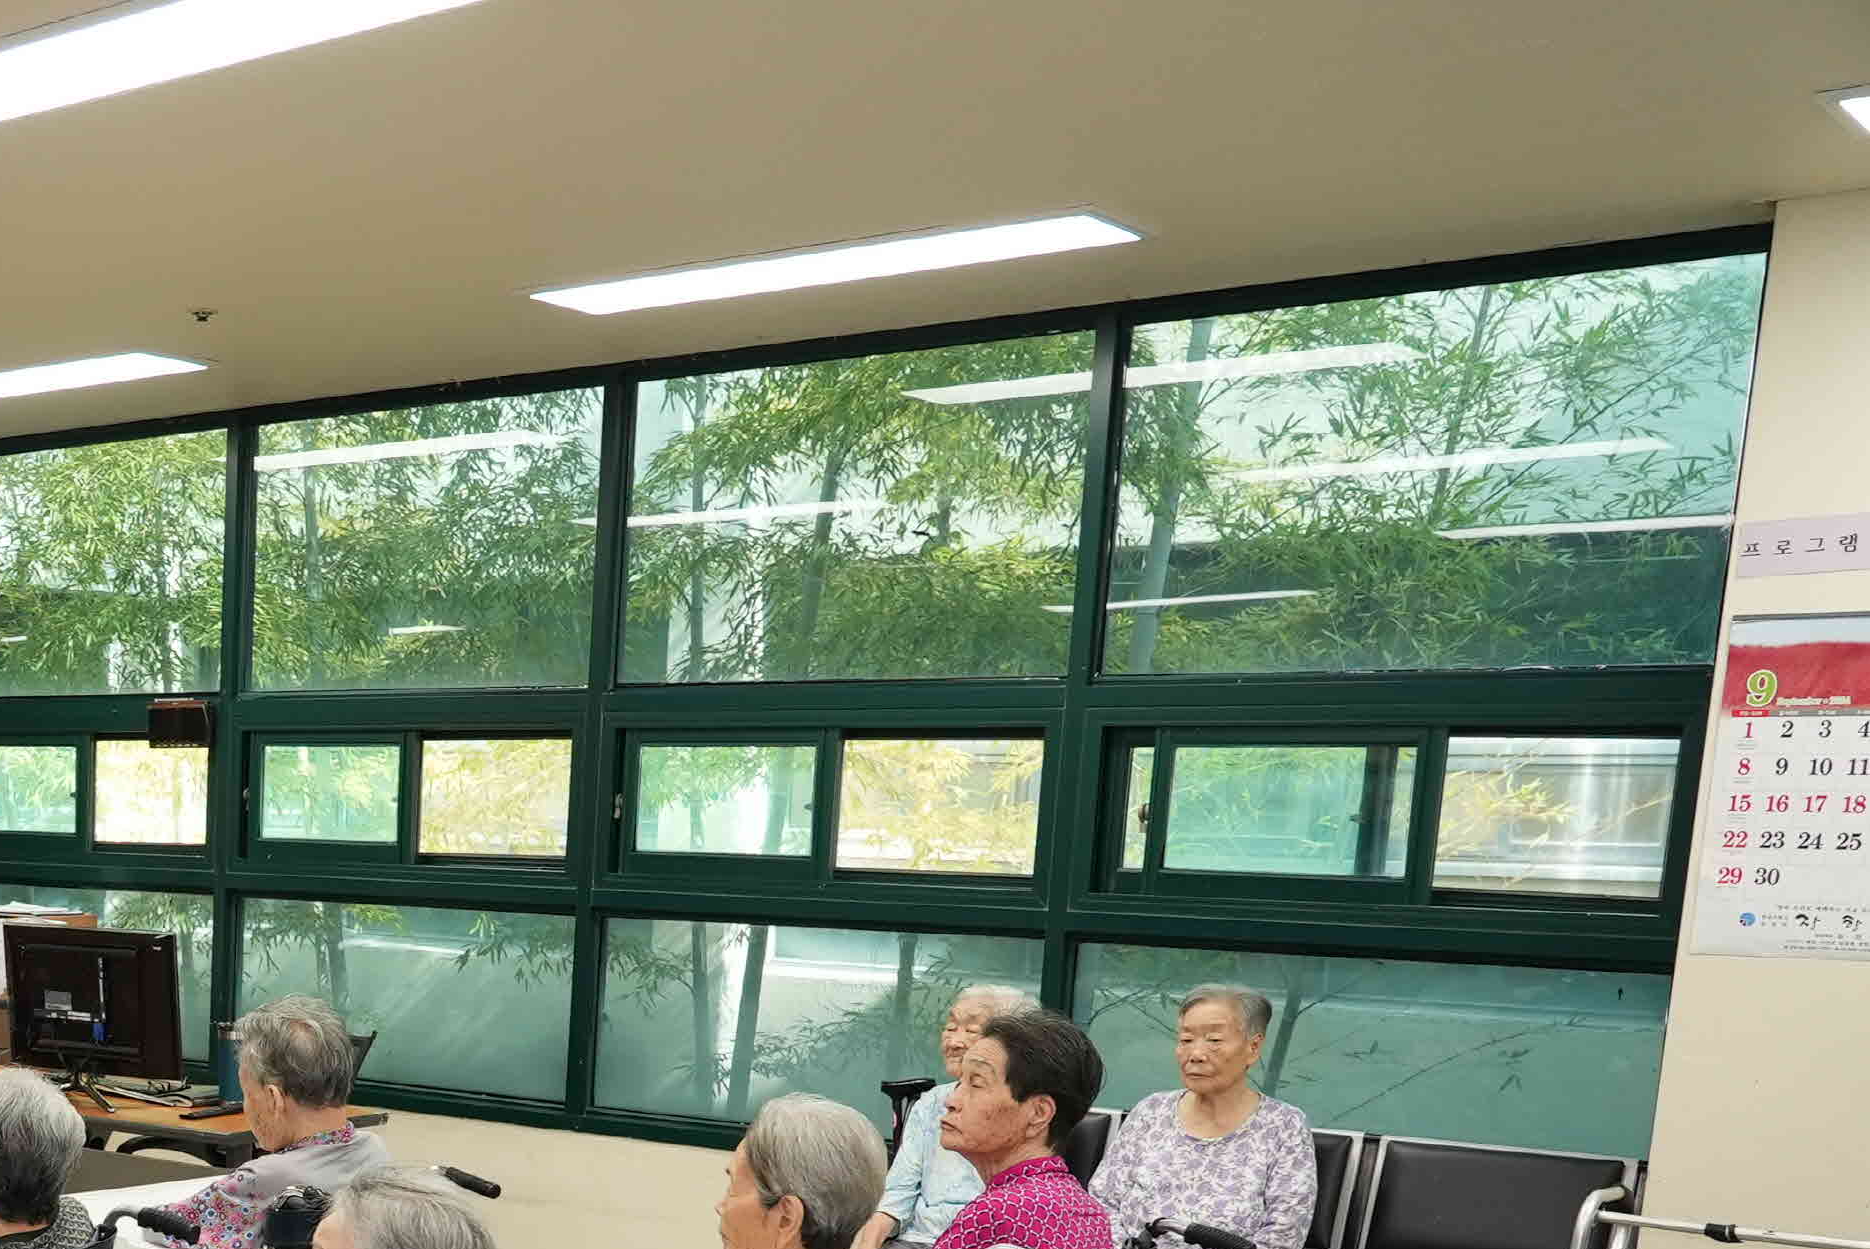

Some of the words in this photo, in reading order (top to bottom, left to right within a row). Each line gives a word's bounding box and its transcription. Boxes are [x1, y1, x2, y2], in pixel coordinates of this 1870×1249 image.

[1740, 532, 1858, 557] 프로그램
[1746, 669, 1778, 707] 9
[1743, 721, 1754, 738] 1
[1780, 720, 1794, 738] 2
[1818, 719, 1832, 738] 3
[1857, 720, 1870, 738] 4
[1737, 758, 1751, 775] 8
[1775, 757, 1789, 776] 9
[1810, 757, 1833, 776] 10
[1847, 758, 1870, 776] 11
[1727, 794, 1752, 812] 15
[1765, 794, 1790, 813] 16
[1802, 794, 1828, 813] 17
[1842, 794, 1867, 814] 18
[1722, 830, 1748, 849] 22
[1759, 831, 1786, 849] 23
[1797, 831, 1824, 850] 24
[1835, 832, 1862, 851] 25
[1716, 866, 1744, 885] 29
[1753, 867, 1781, 886] 30
